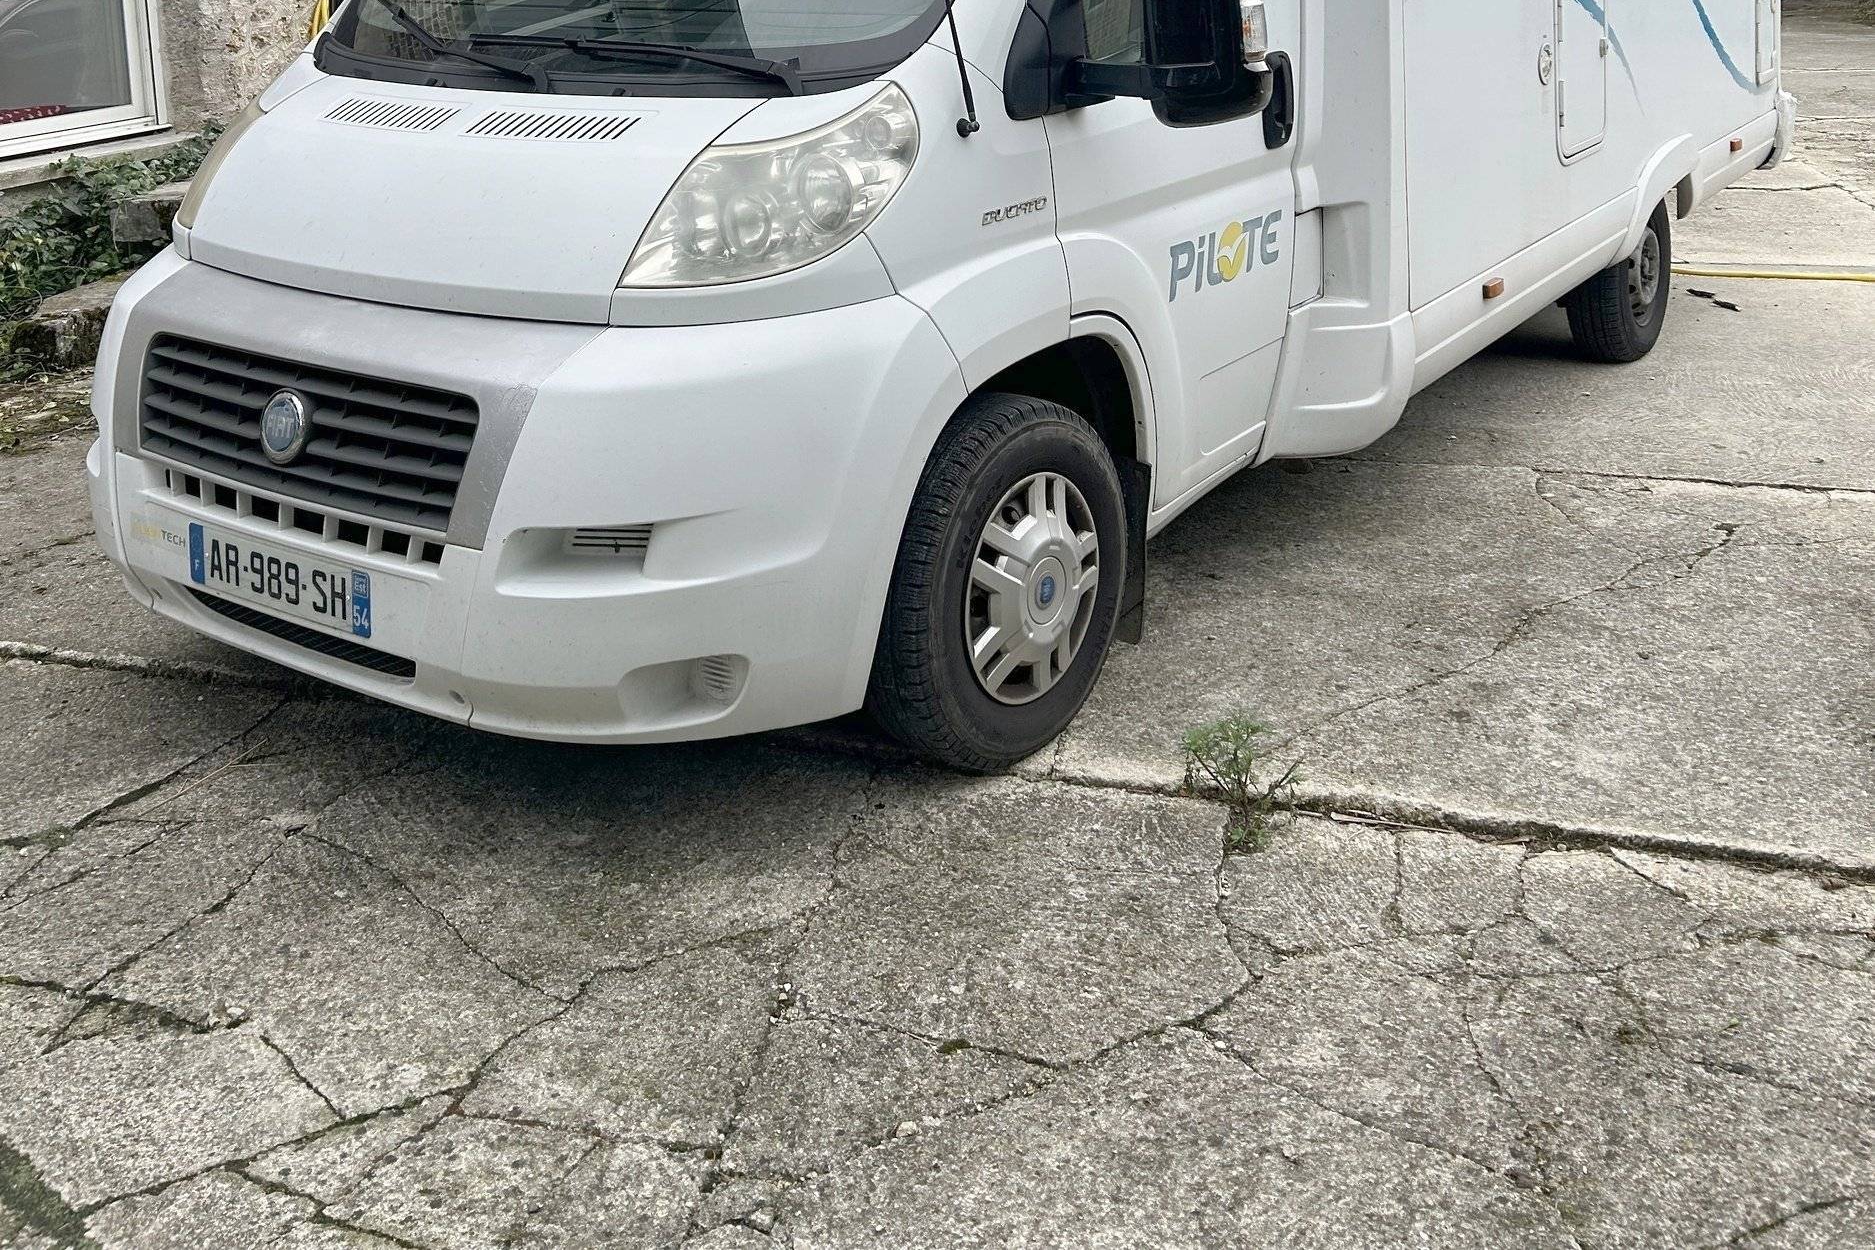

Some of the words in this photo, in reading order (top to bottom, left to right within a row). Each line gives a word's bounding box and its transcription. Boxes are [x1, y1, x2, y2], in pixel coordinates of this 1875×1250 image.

[982, 195, 1047, 227] DUCATO
[266, 414, 295, 439] FIAT
[193, 560, 200, 572] F
[210, 538, 347, 621] AR-989-SH
[353, 604, 369, 630] 54
